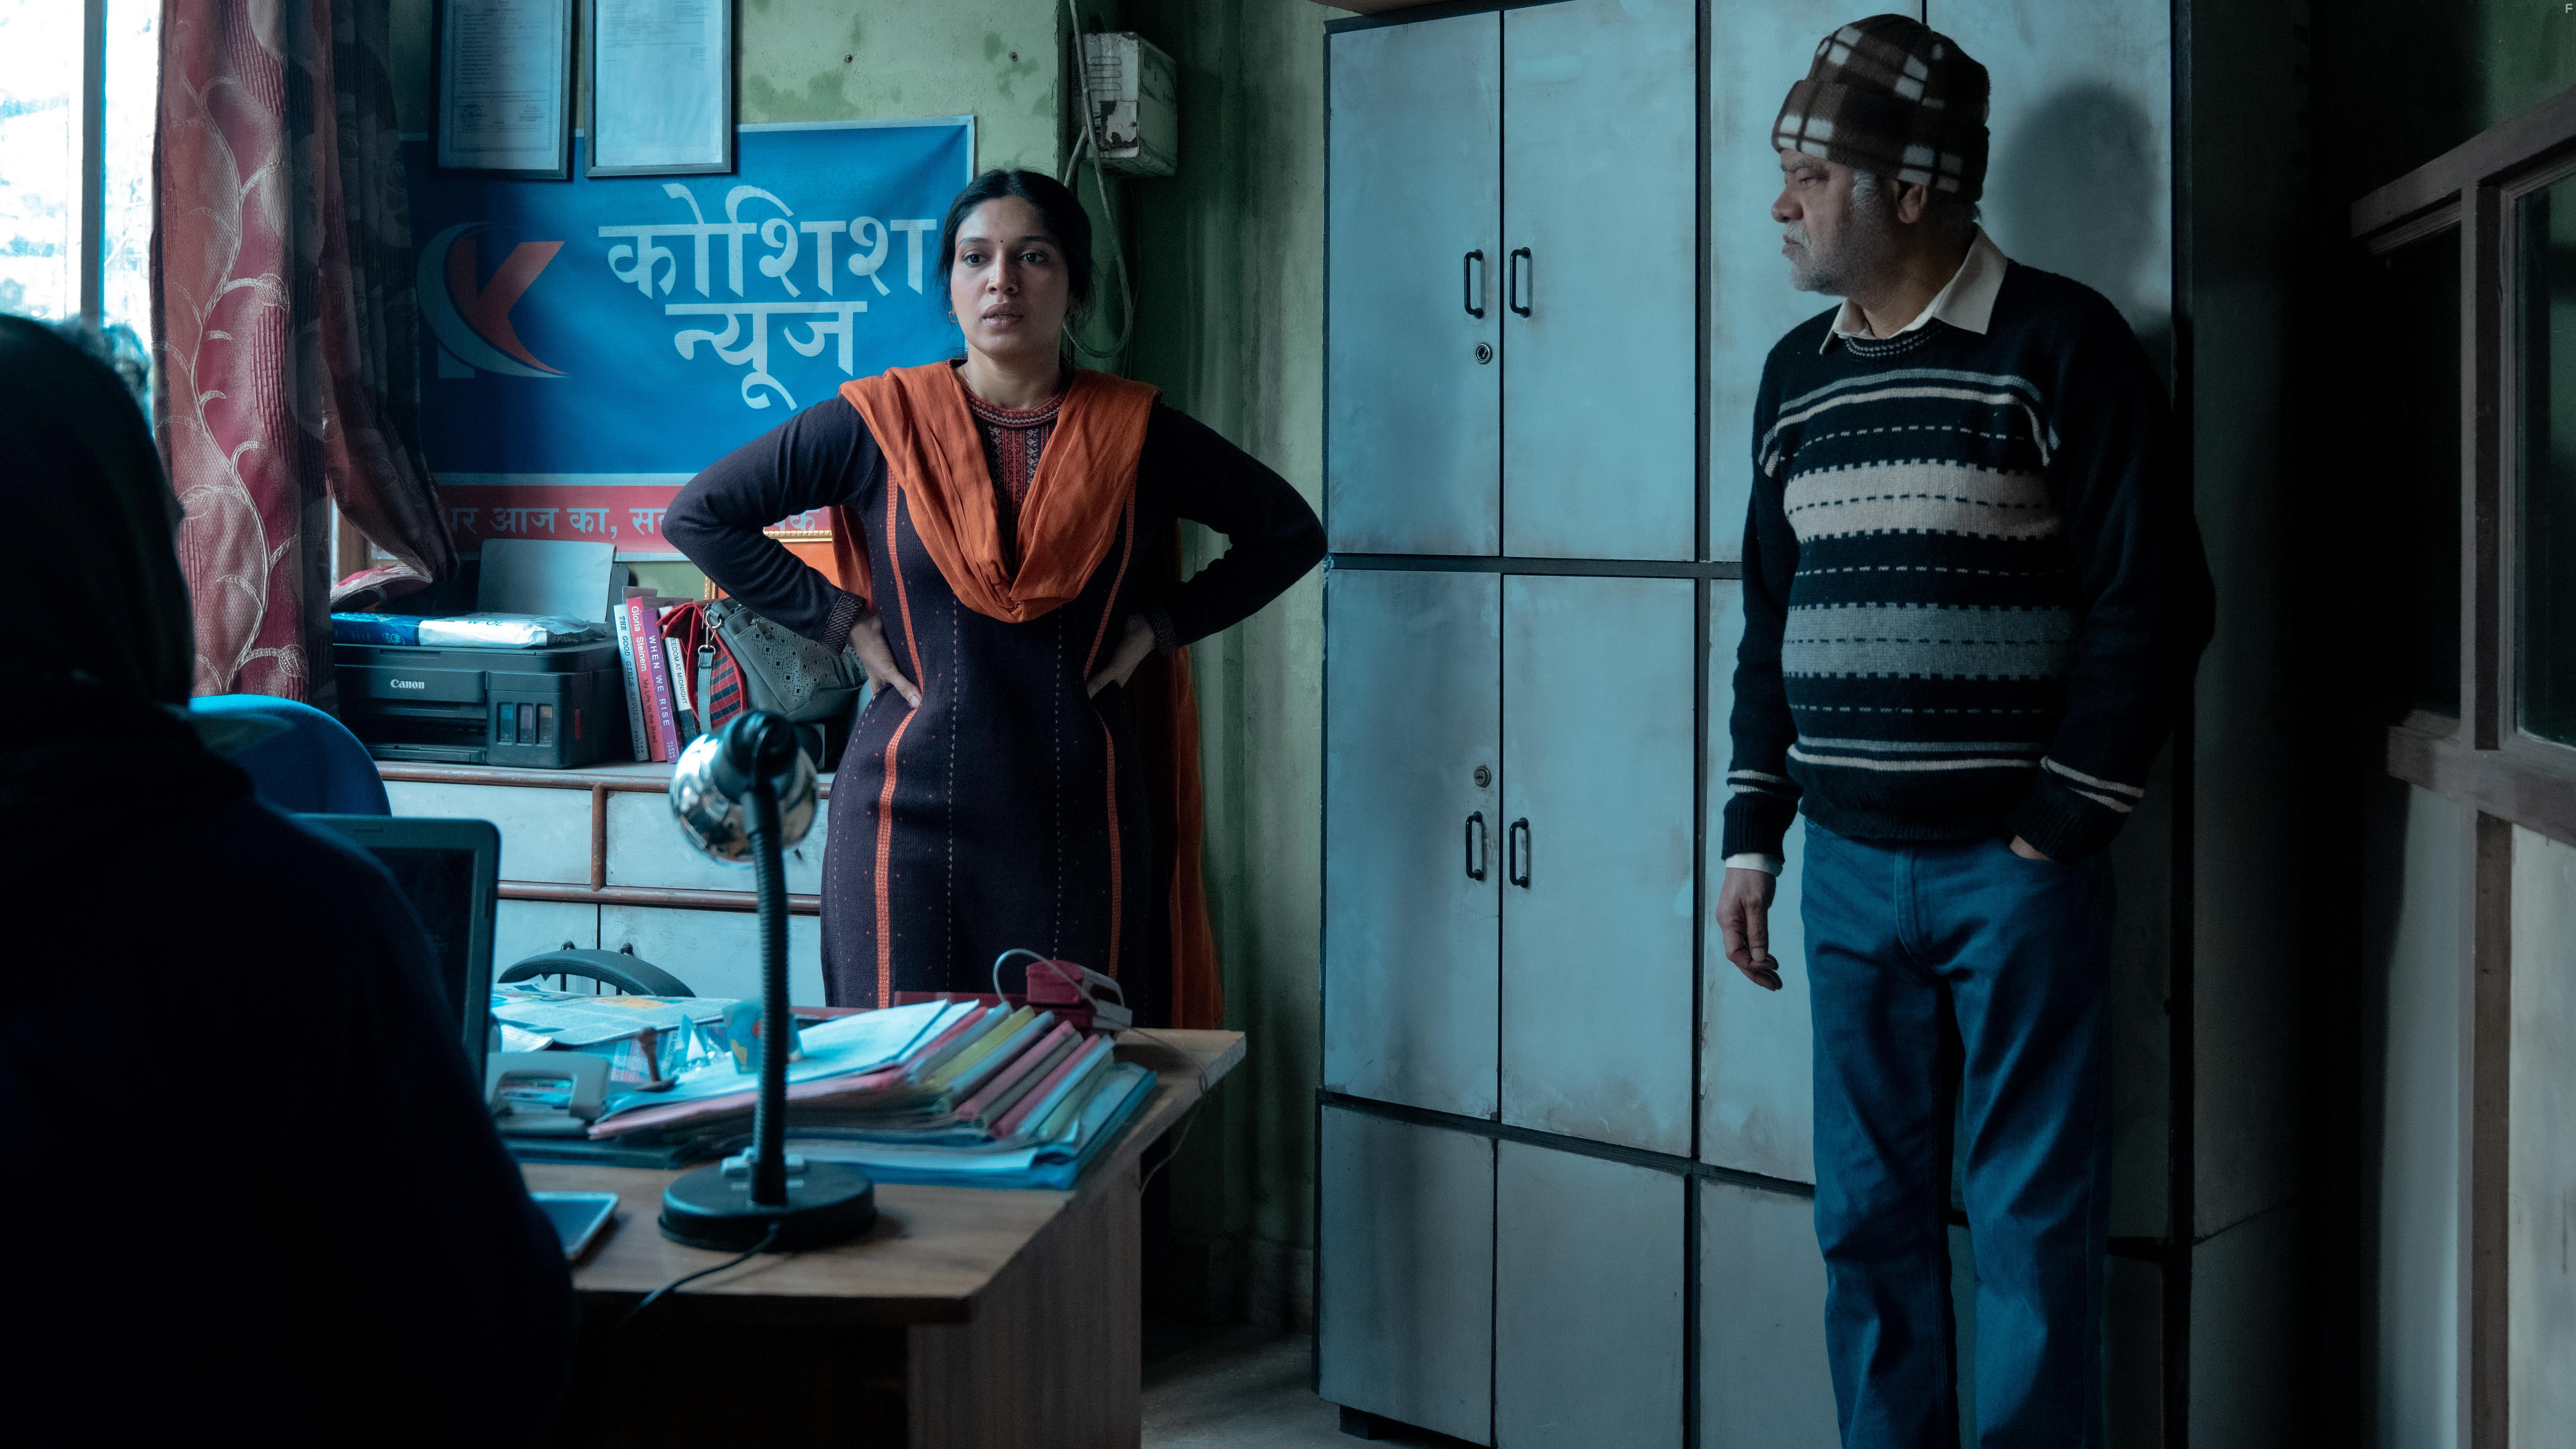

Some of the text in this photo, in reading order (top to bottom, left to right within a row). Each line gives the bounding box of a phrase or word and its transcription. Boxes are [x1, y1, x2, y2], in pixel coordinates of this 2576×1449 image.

[598, 183, 937, 298] कोशिश
[665, 301, 868, 411] न्यूज
[451, 508, 479, 534] ार
[490, 508, 559, 534] आज
[567, 508, 617, 540] का,
[631, 606, 647, 672] Gloria Steinem
[390, 679, 425, 689] Canon
[626, 661, 635, 686] GIRLS
[643, 679, 648, 689] My
[647, 704, 652, 712] on
[648, 635, 670, 726] WHEN WE RISE
[671, 638, 688, 704] EEDOM AT MIDNIGHT
[630, 691, 639, 722] REVOLT
